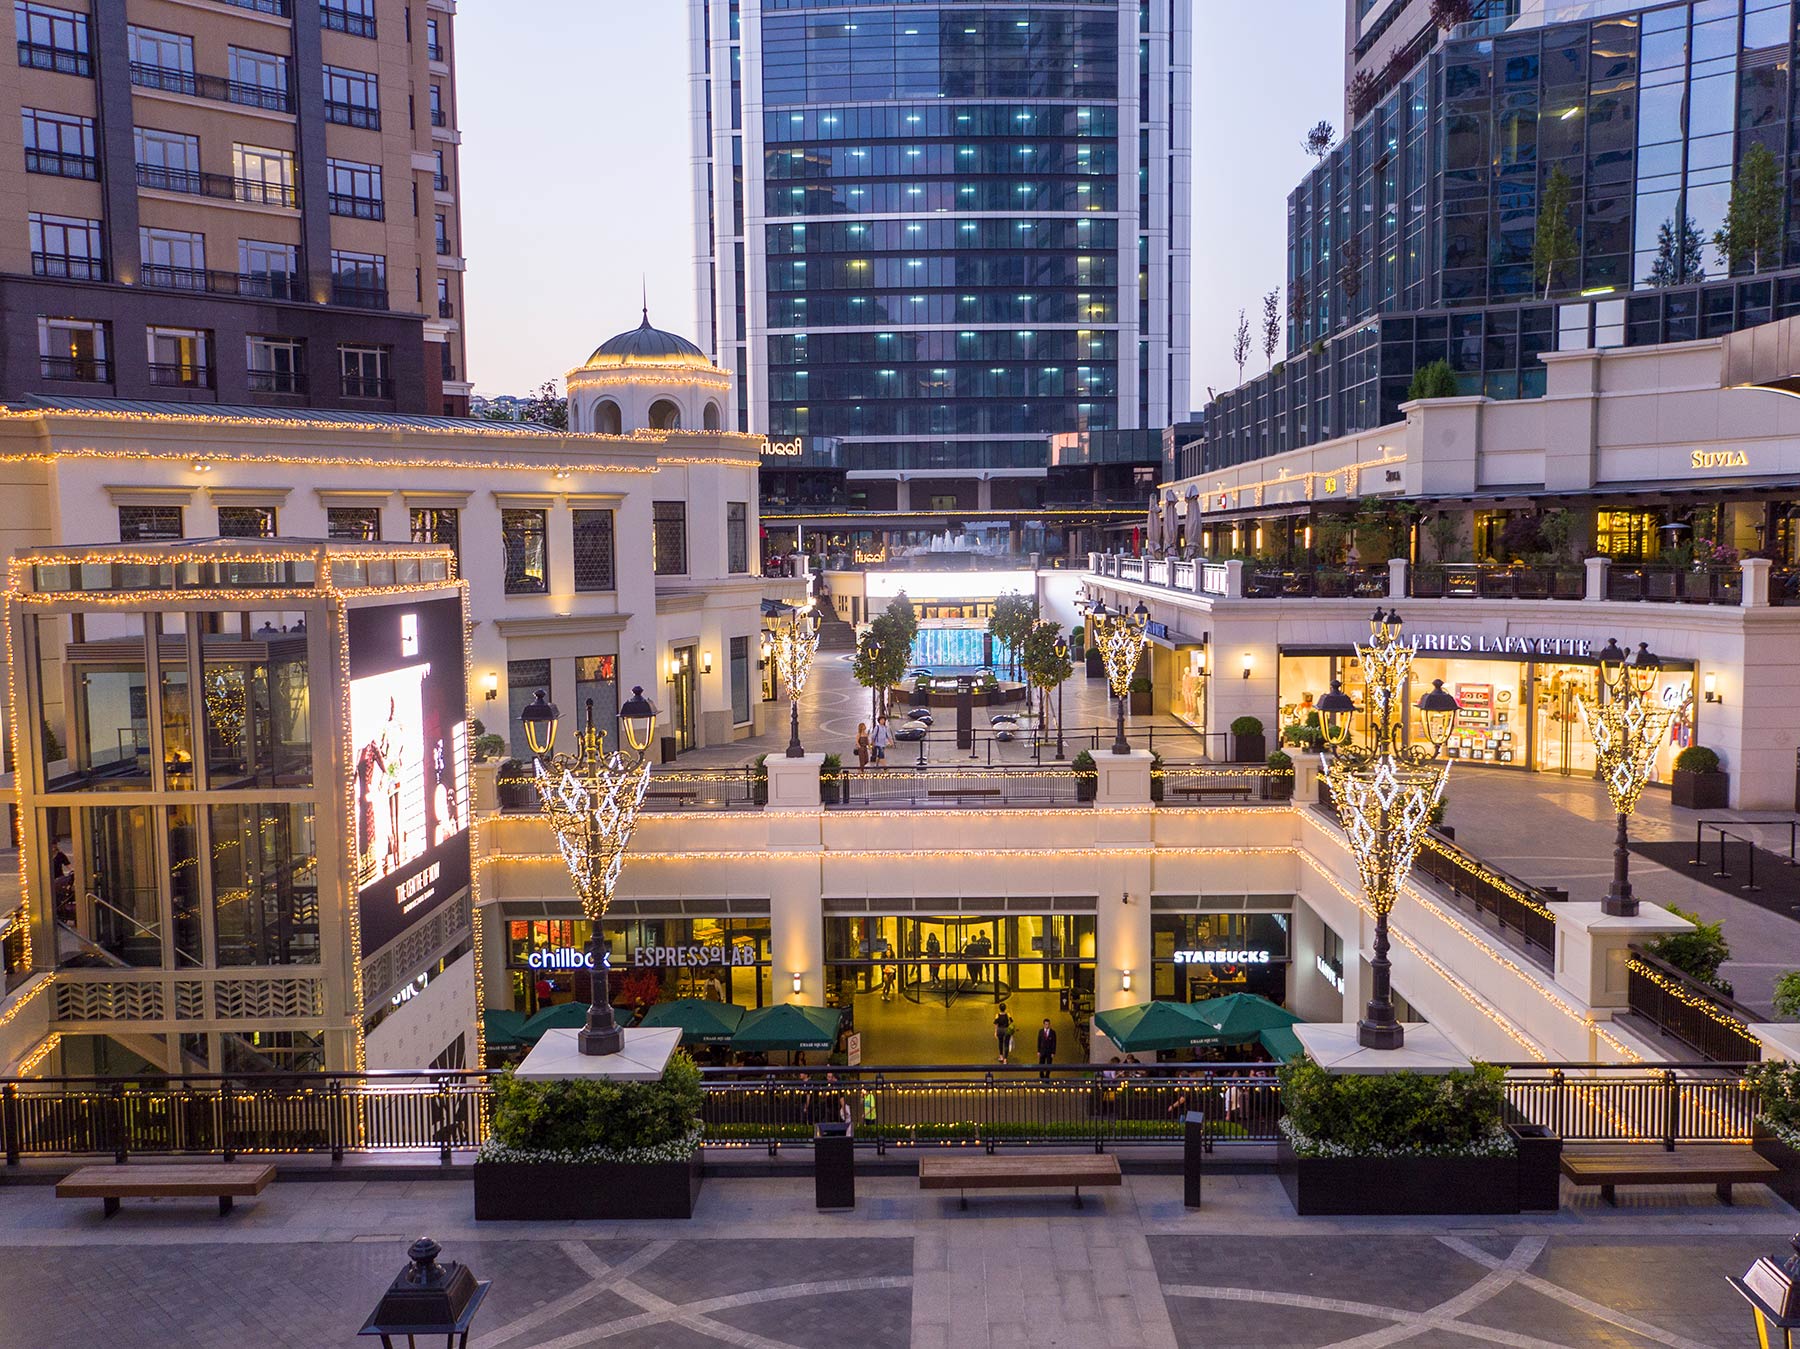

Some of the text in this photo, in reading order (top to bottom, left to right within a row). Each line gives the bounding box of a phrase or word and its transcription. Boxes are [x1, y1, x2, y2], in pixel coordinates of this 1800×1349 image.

[1690, 449, 1749, 469] SUVLA
[1479, 635, 1592, 657] LAFAYETTE
[1173, 950, 1269, 963] STARBUCKS
